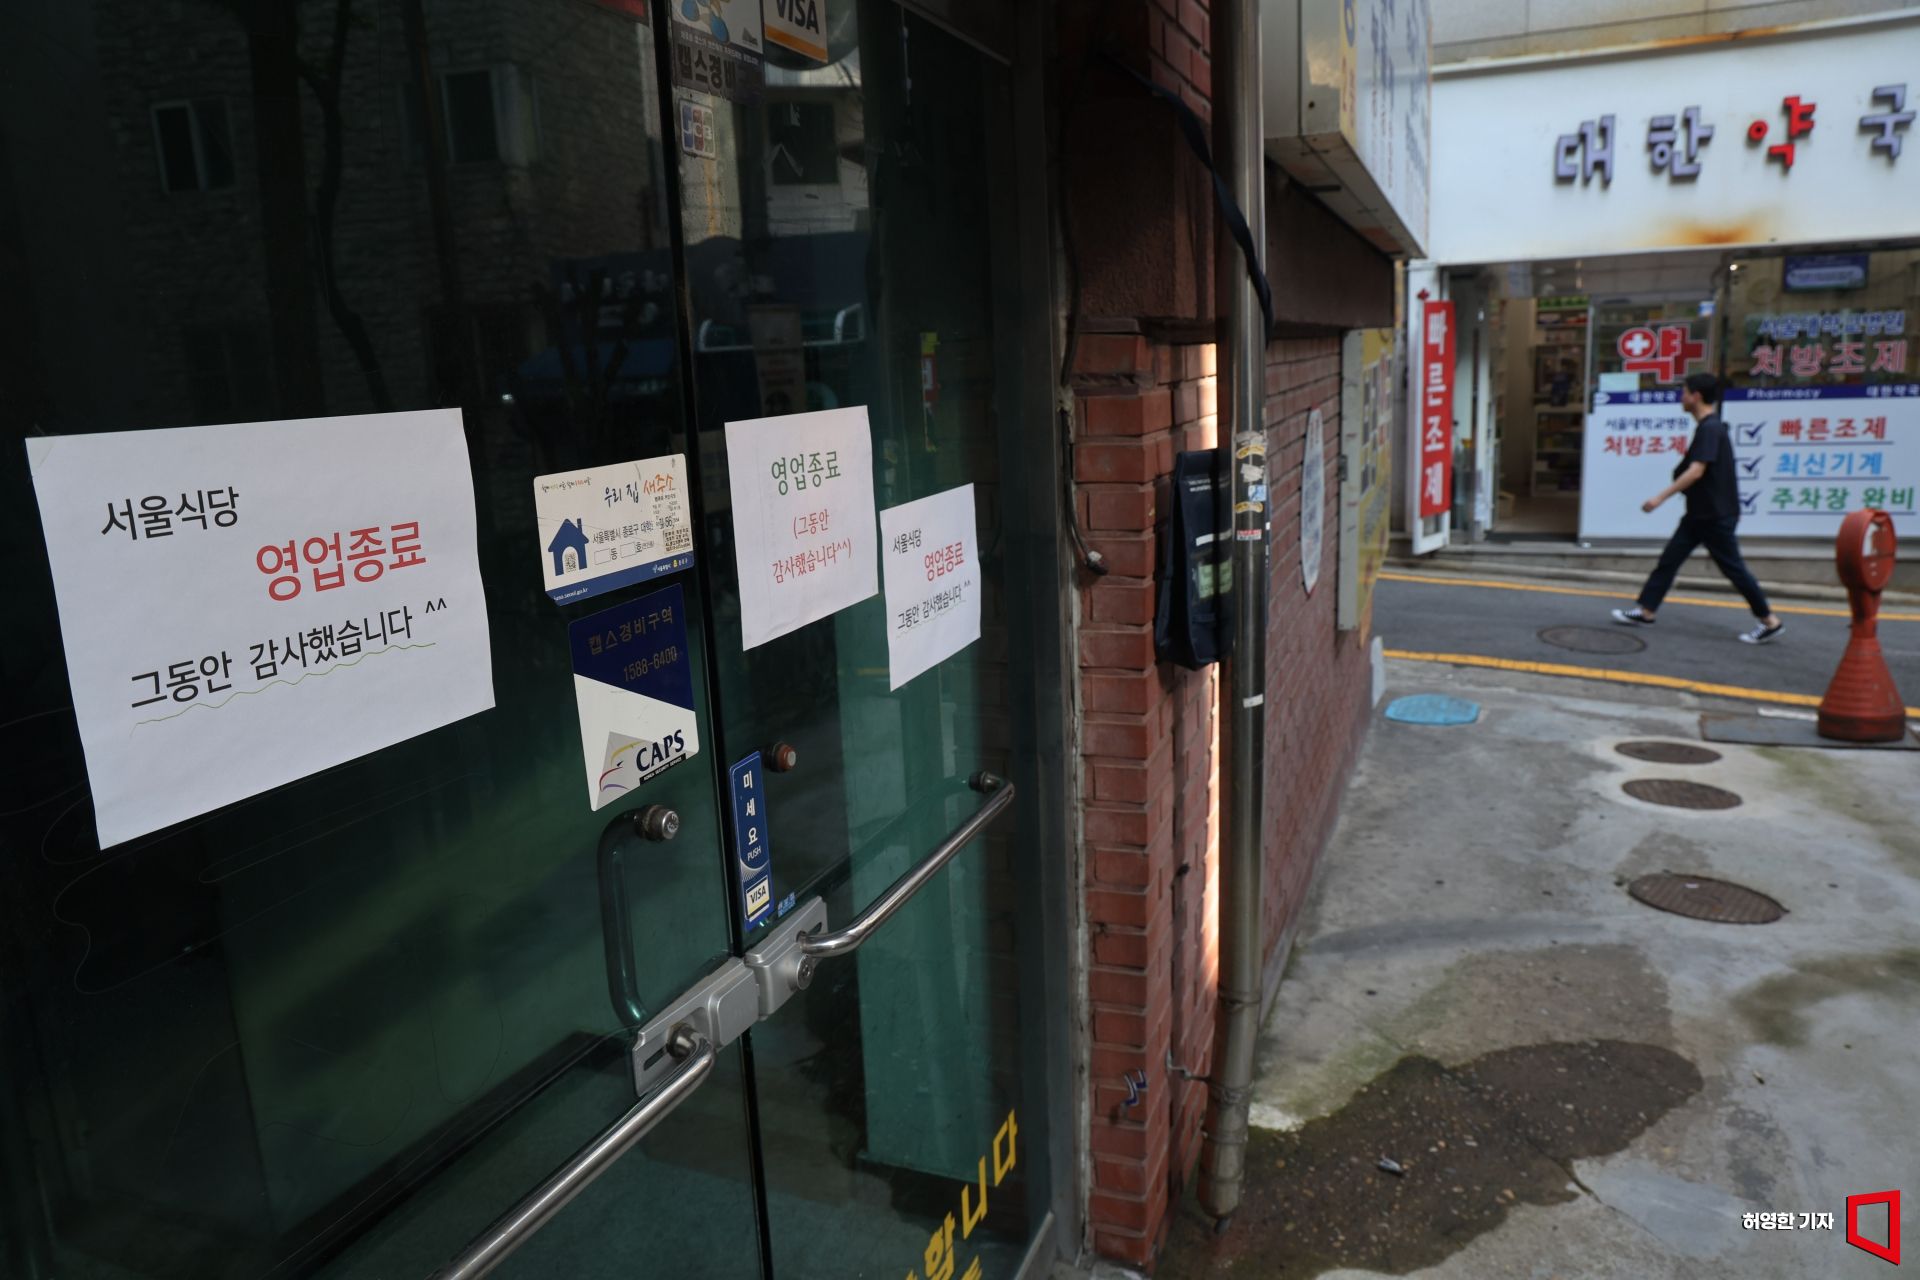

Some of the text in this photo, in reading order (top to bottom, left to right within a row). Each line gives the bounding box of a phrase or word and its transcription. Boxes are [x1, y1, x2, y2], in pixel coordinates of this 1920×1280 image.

[776, 0, 820, 34] VISA
[1553, 83, 1917, 186] 대한약국
[1757, 310, 1905, 339] 서울대학교병원
[1617, 324, 1692, 383] 약
[1750, 340, 1907, 377] 처방조제
[1424, 309, 1447, 505] 빠른조제
[1604, 435, 1688, 457] 처방조제
[1779, 417, 1887, 441] 빠른조제
[771, 450, 841, 496] 영업종료
[1775, 452, 1883, 476] 최신기계
[604, 487, 622, 508] 우리
[643, 473, 674, 496] 새주소
[1771, 487, 1914, 511] 주차장 완비
[101, 486, 239, 541] 서울식당
[793, 508, 829, 539] (그동안
[893, 527, 922, 554] 서울식당
[255, 520, 426, 602] 영업종료
[924, 542, 964, 582] 영업종료
[898, 604, 919, 629] 그동안
[921, 584, 962, 619] 감사했습니다
[131, 651, 232, 708] 그동안
[249, 606, 413, 681] 감사했습니다
[636, 729, 684, 771] CAPS
[743, 770, 758, 846] 미세요
[747, 846, 761, 861] PUSH
[750, 885, 767, 904] VISA
